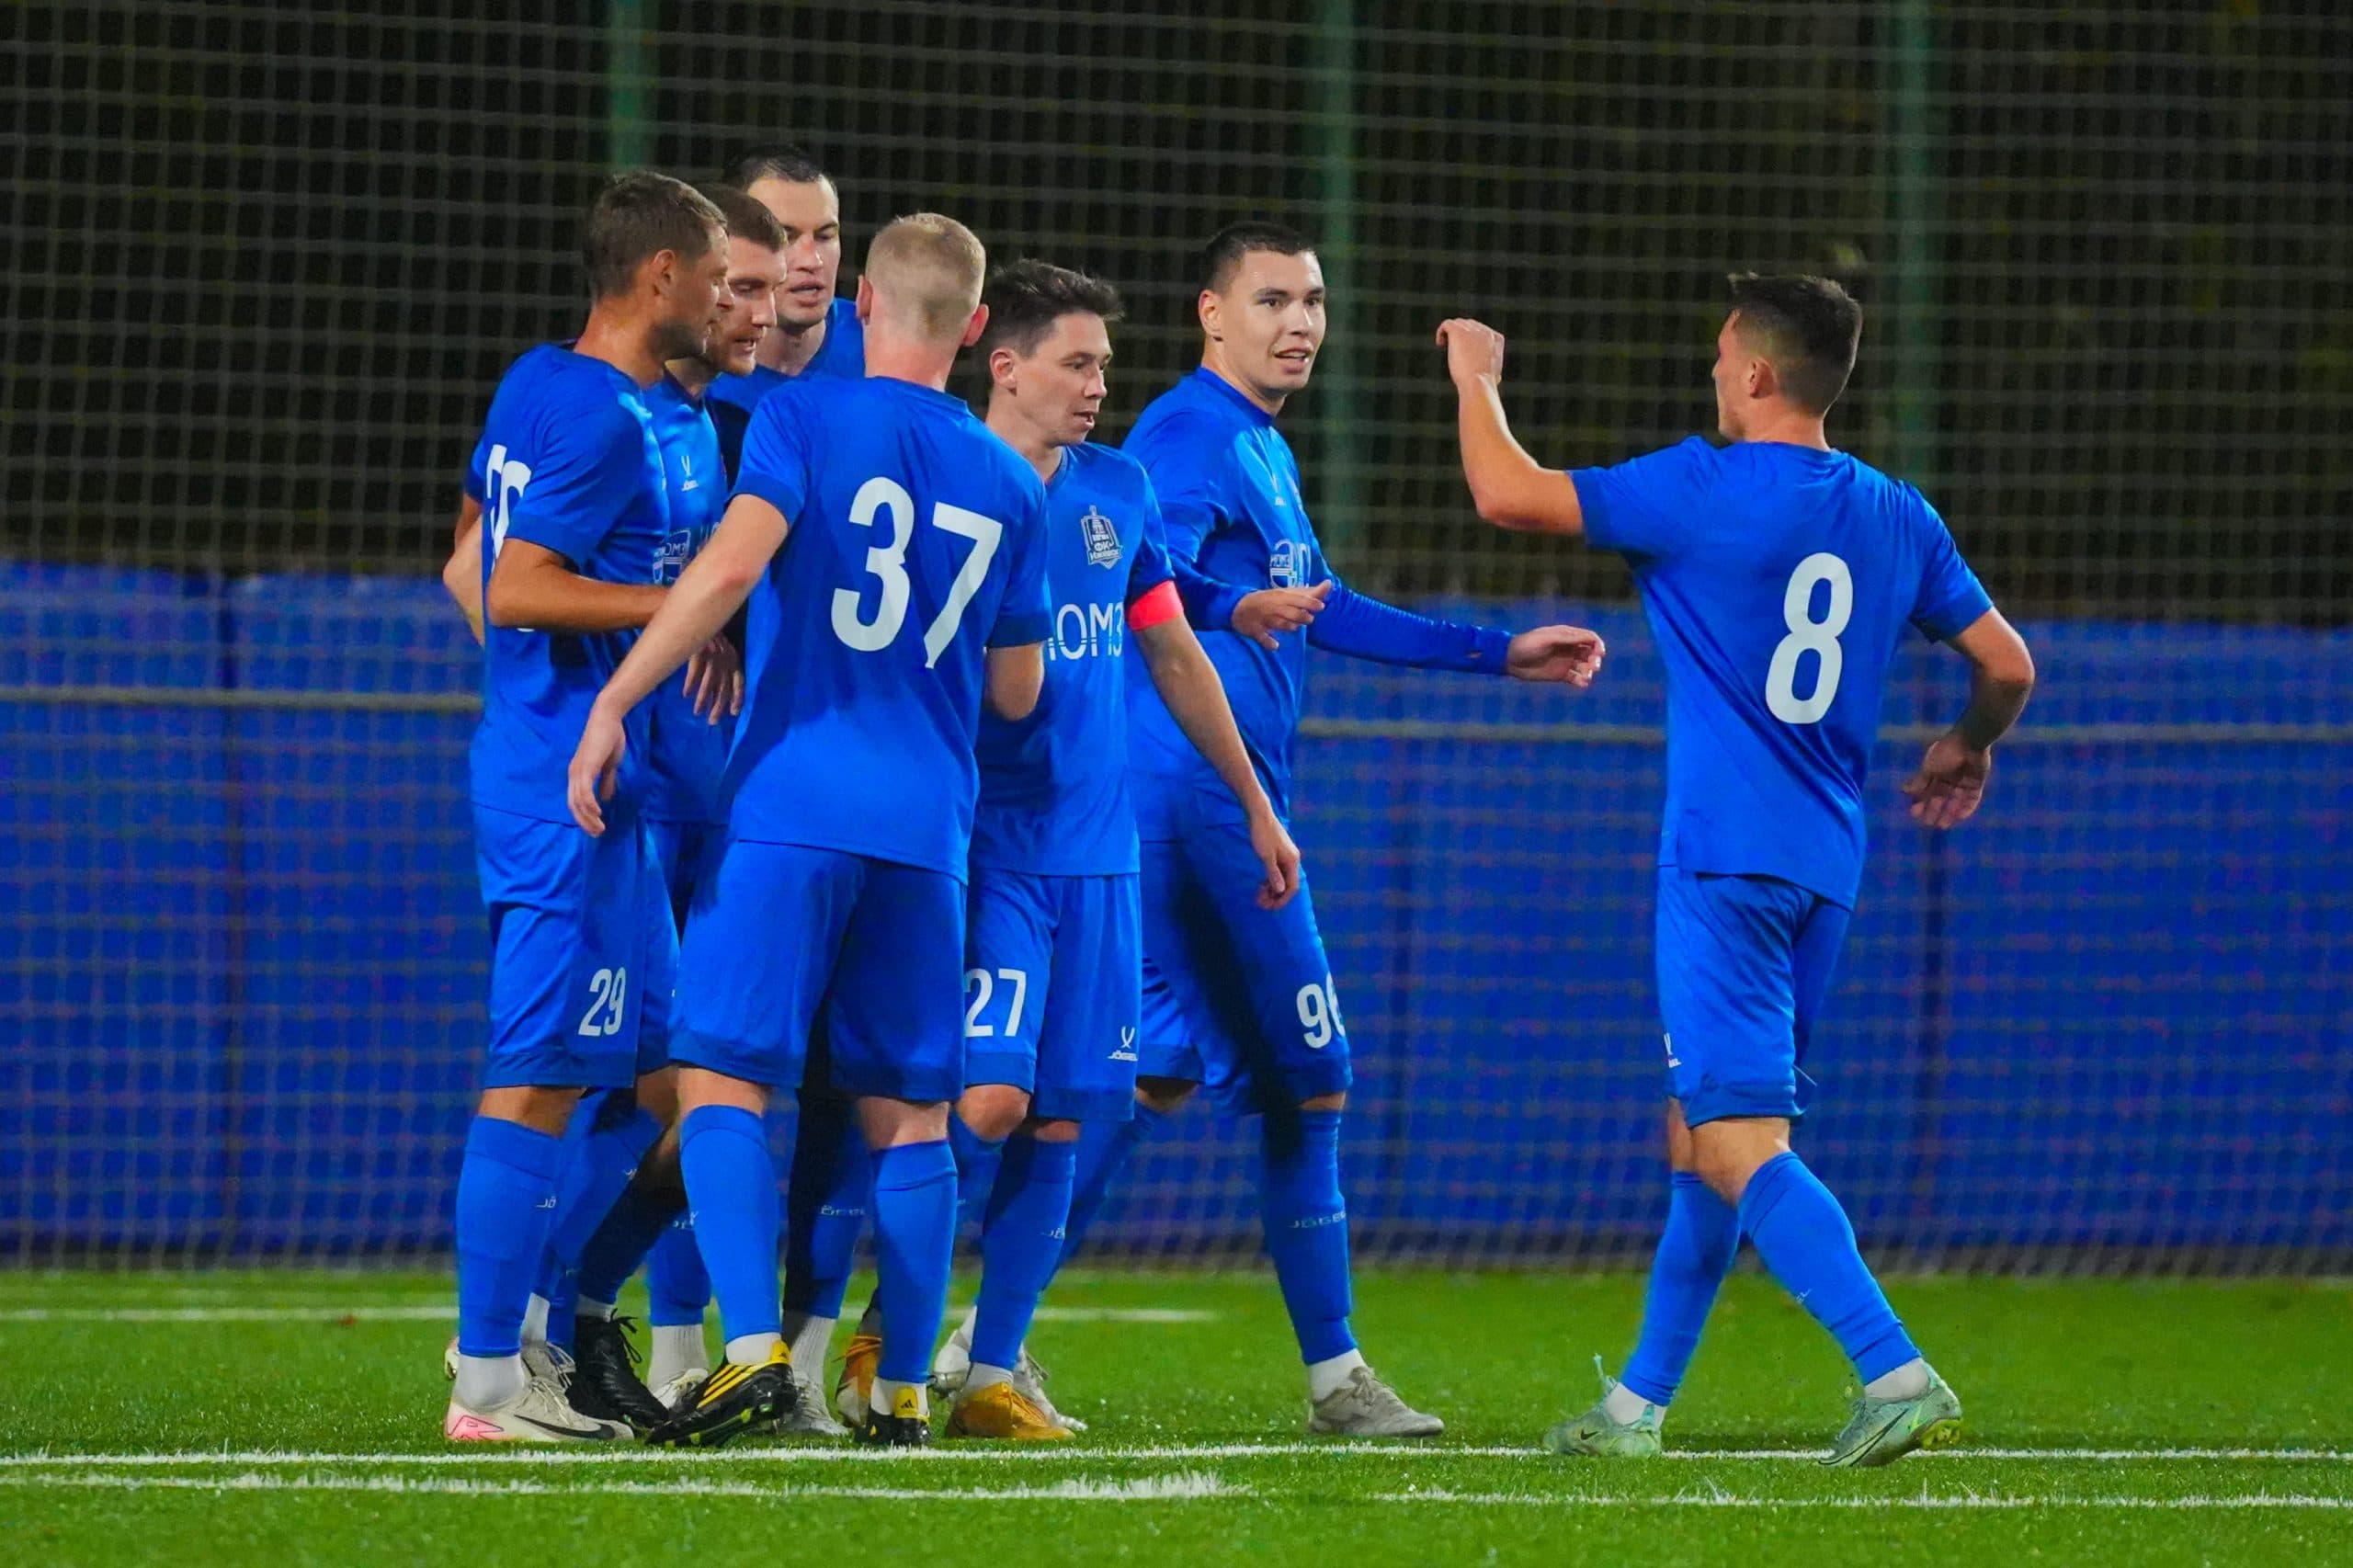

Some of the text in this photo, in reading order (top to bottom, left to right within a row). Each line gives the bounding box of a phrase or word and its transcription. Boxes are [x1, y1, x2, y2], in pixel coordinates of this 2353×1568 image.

[831, 476, 1003, 669] 37
[1765, 552, 1853, 724] 8
[578, 967, 626, 1036] 29
[963, 968, 1026, 1037] 27
